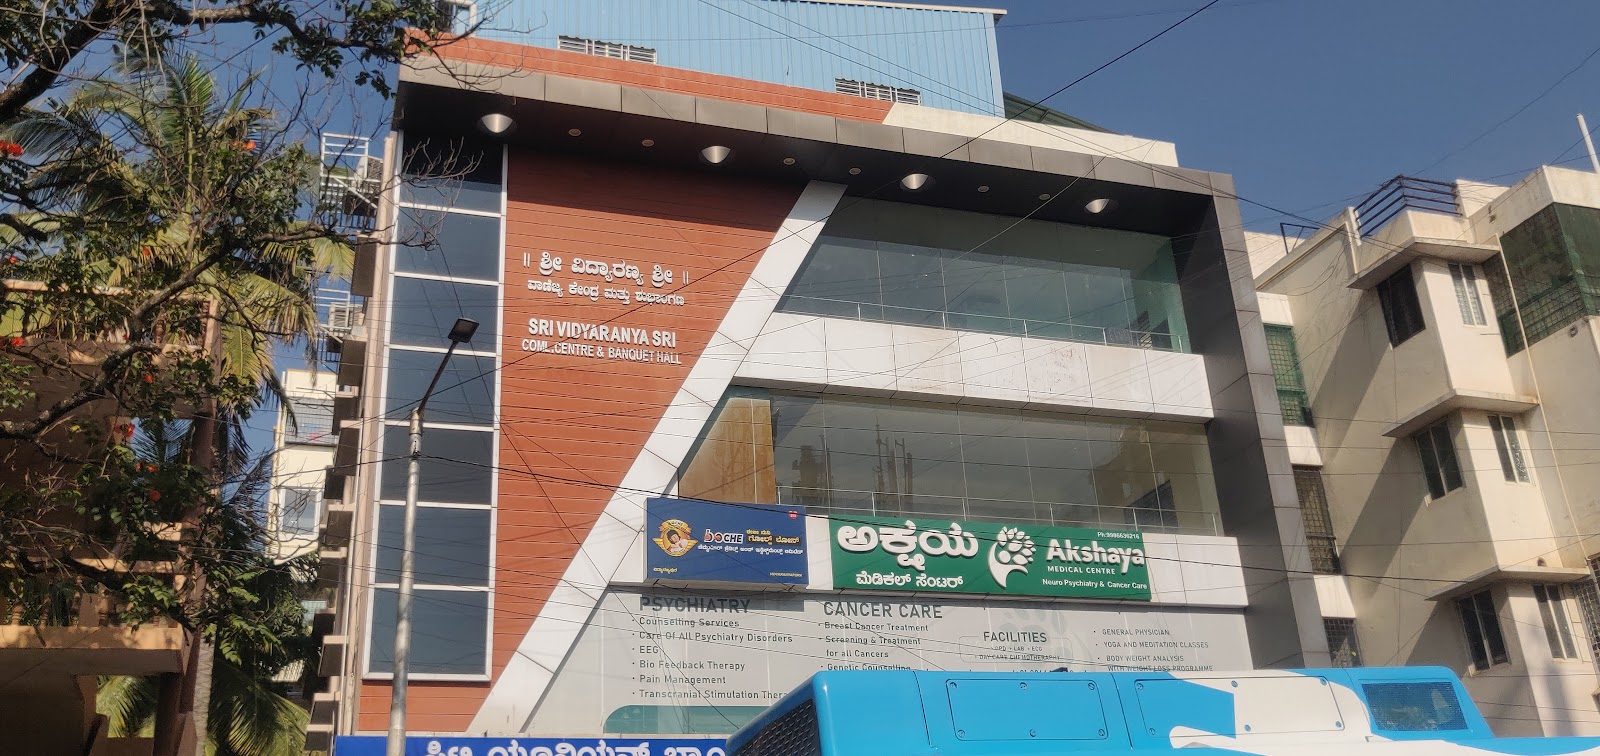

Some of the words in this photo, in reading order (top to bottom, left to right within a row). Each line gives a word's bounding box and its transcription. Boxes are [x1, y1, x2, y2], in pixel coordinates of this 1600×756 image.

[539, 251, 562, 276] ಶ್ರೀ
[571, 257, 644, 285] ವಿದ್ಯಾರಣ್ಯ
[651, 264, 673, 288] ಶ್ರೀ
[527, 279, 564, 297] ವಾಣಿಜ್ಯ
[568, 281, 600, 302] ಕೇಂದ್ರ
[604, 286, 631, 305] ಮತ್ತು
[528, 318, 554, 337] SRI
[556, 320, 650, 346] VIDYARANYA
[652, 330, 676, 348] SRI
[596, 346, 605, 359] &
[608, 347, 656, 363] BANQUET
[657, 351, 682, 365] HALL
[837, 519, 979, 572] ಅಕ್ಷಯ
[1046, 538, 1145, 574] Akshaya
[1047, 565, 1083, 573] MEDICAL
[1086, 567, 1116, 575] CENTRE
[856, 570, 912, 586] ಮೆಡಿಕಲ್
[916, 573, 964, 588] ಸೆಂಟರ್
[1042, 578, 1063, 586] Neuro
[1064, 579, 1098, 588] Psychiatry
[1107, 581, 1131, 589] Cancer
[640, 596, 751, 614] PSYCHIATRY
[823, 602, 893, 618] CANCER
[899, 604, 943, 619] CARE
[639, 617, 695, 628] Counselling
[698, 619, 740, 628] Services
[824, 622, 853, 630] Breast
[855, 622, 885, 631] Cancer
[887, 623, 929, 632] Treatment
[639, 632, 662, 640] Care
[665, 632, 676, 640] Of
[679, 632, 693, 641] All
[695, 633, 744, 644] Psychiatry
[747, 634, 793, 643] Disorders
[825, 635, 868, 645] Screening
[879, 637, 921, 645] Treatment
[983, 631, 1047, 643] FACILITIES
[639, 646, 659, 654] EEG
[826, 650, 839, 658] for
[841, 650, 852, 658] all
[855, 650, 889, 658] Cancers
[639, 660, 655, 669] Bio
[659, 661, 704, 670] Feedback
[707, 661, 746, 672] Therapy
[639, 675, 661, 683] Pain
[664, 675, 726, 685] Management
[639, 690, 701, 699] Transcranial
[704, 690, 759, 699] Stimulation
[761, 691, 788, 699] Thera
